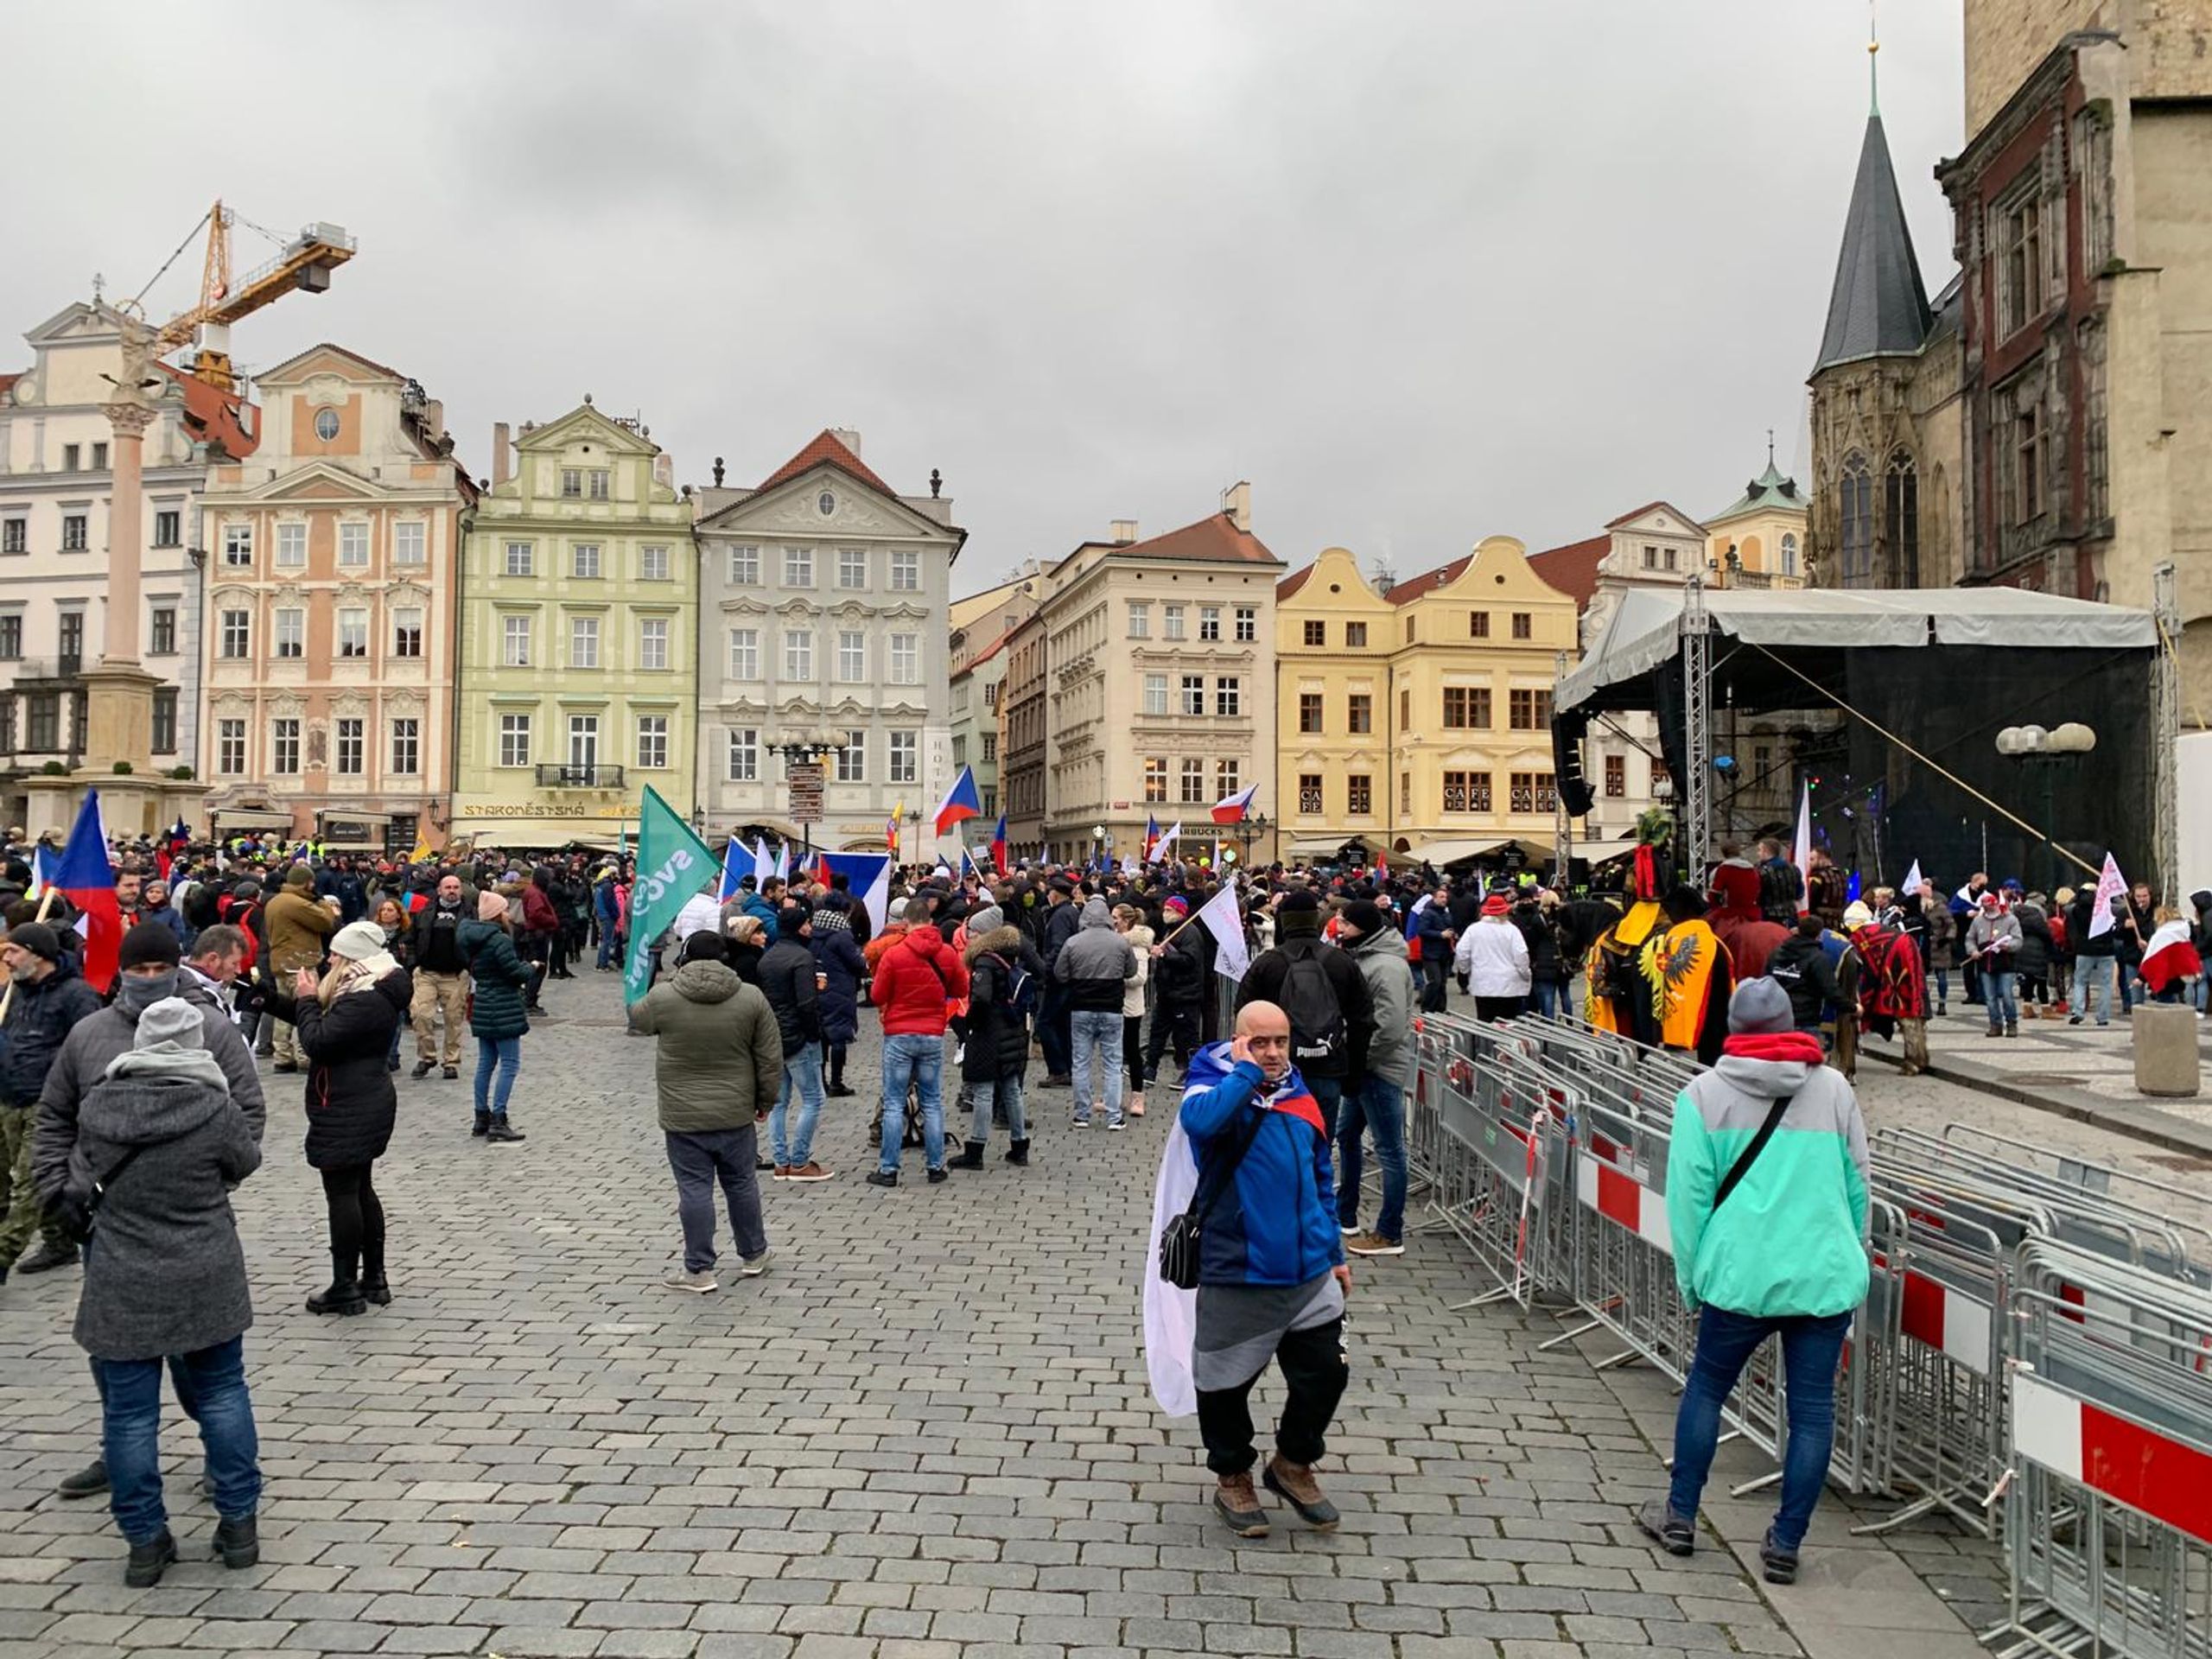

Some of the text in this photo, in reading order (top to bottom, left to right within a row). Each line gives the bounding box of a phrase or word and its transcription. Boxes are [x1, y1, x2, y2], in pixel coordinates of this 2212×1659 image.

[933, 741, 943, 804] HOTEL
[1445, 788, 1491, 799] CAFE
[1511, 789, 1556, 799] CAFE
[464, 802, 585, 816] STAROMĚSTSKÁ
[1164, 827, 1224, 836] SARBUCKS
[1296, 1046, 1328, 1058] PUMA
